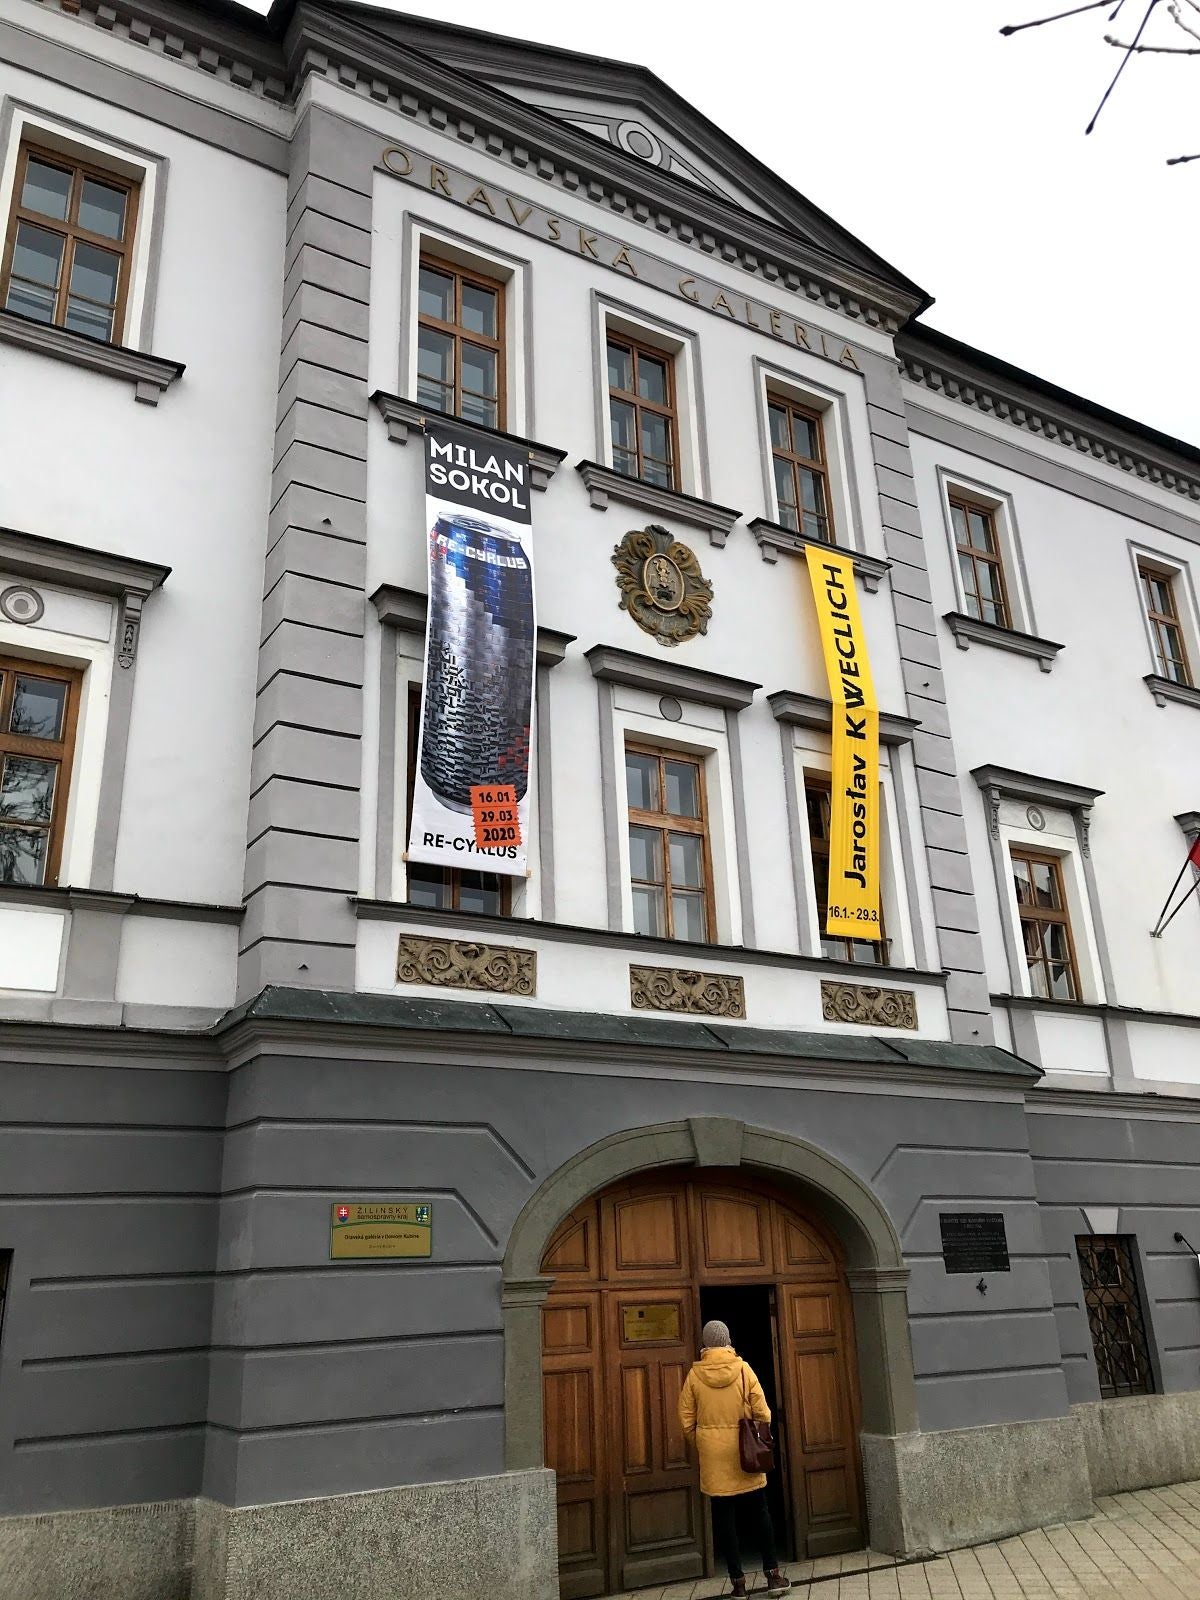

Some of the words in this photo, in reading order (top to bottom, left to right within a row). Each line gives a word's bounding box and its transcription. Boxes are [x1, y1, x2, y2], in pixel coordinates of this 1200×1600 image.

[383, 146, 637, 276] ORAVSKÁ
[678, 278, 859, 370] GALÉRIA
[430, 436, 524, 486] MILAN
[430, 463, 526, 509] SOKOL
[483, 827, 515, 841] 2020
[856, 908, 879, 921] 29.3.
